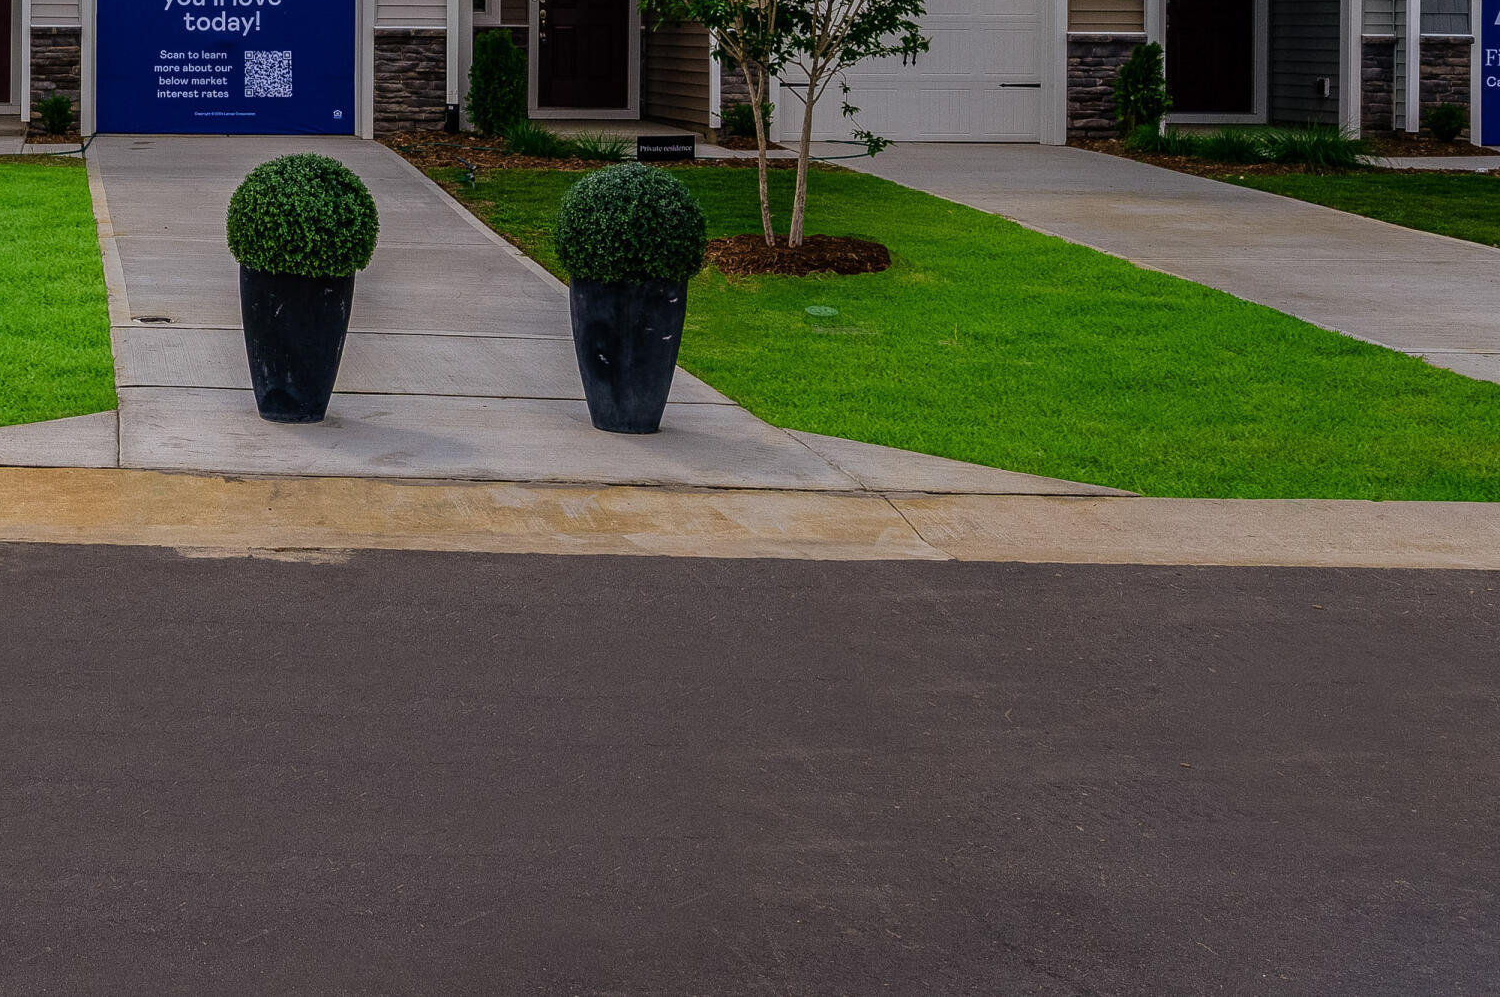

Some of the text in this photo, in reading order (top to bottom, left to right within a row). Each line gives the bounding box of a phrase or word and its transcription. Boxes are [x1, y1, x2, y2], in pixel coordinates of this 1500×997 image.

[183, 10, 261, 36] today!
[159, 49, 228, 59] Scan to learn
[182, 63, 213, 72] about
[158, 76, 228, 85] below market
[157, 89, 229, 98] interest rates
